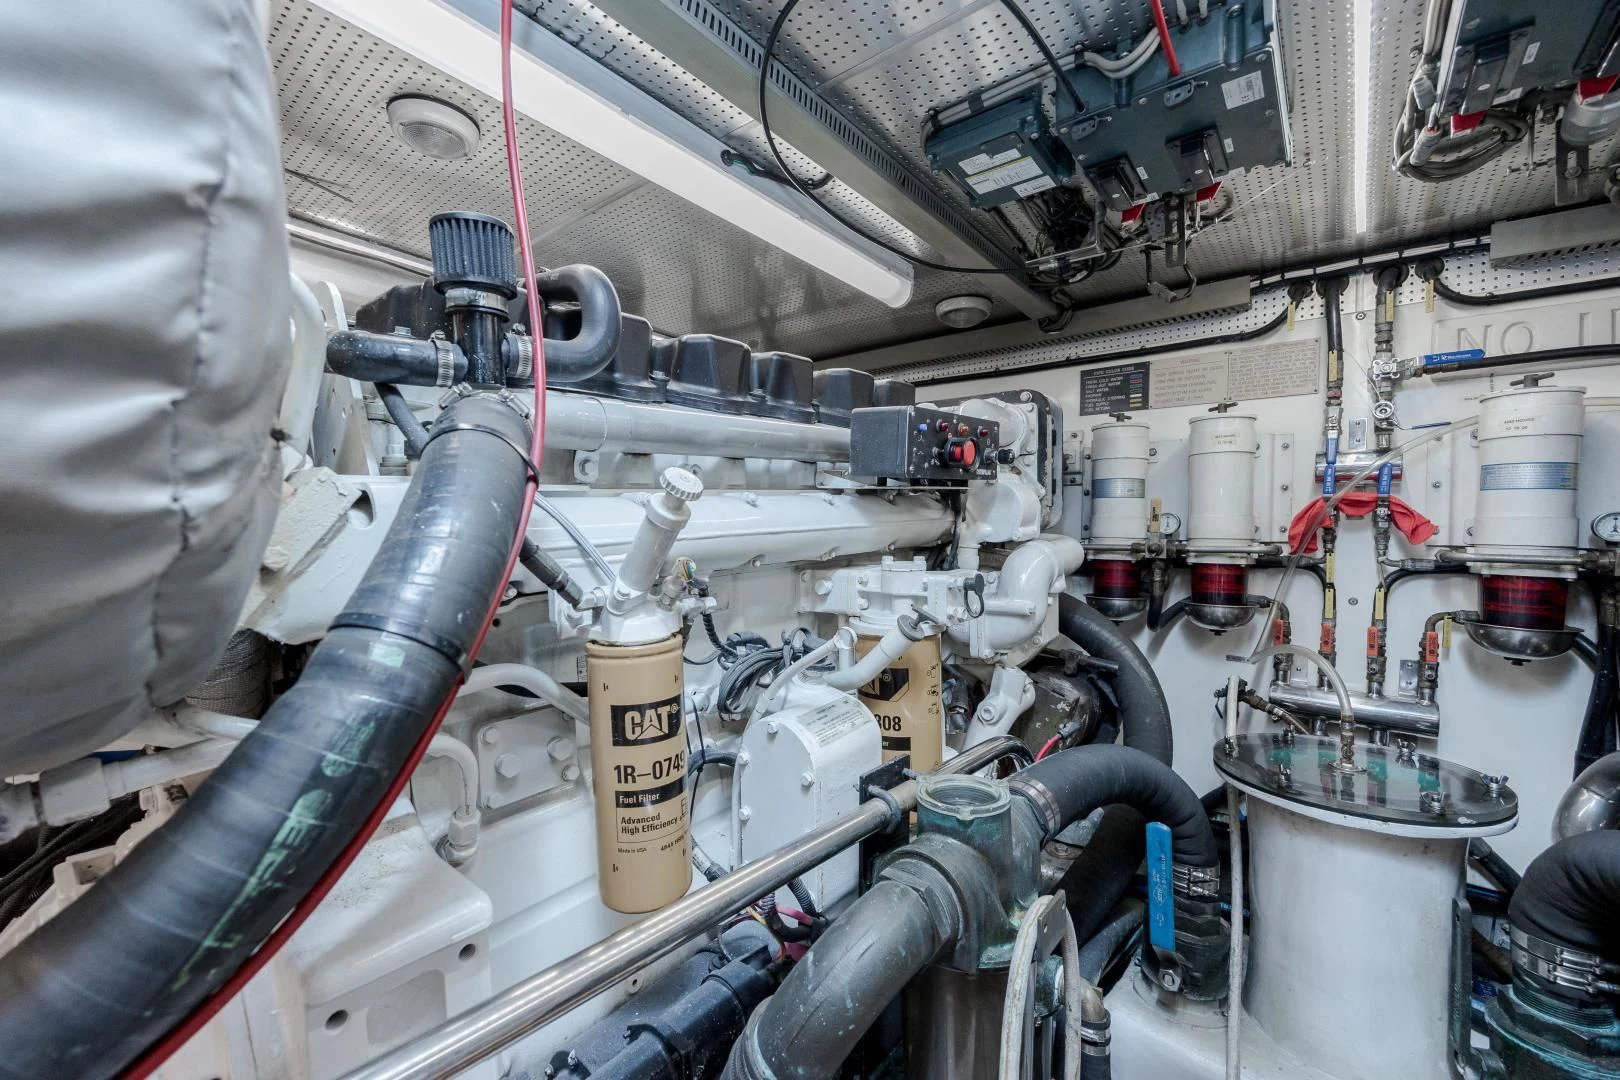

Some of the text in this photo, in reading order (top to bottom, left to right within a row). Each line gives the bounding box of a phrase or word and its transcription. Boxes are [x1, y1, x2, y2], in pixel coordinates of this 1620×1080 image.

[614, 749, 685, 784] 1R-0749
[619, 793, 660, 804] Fuel Filter
[621, 812, 661, 825] Advanced
[621, 816, 678, 836] High Efficiency
